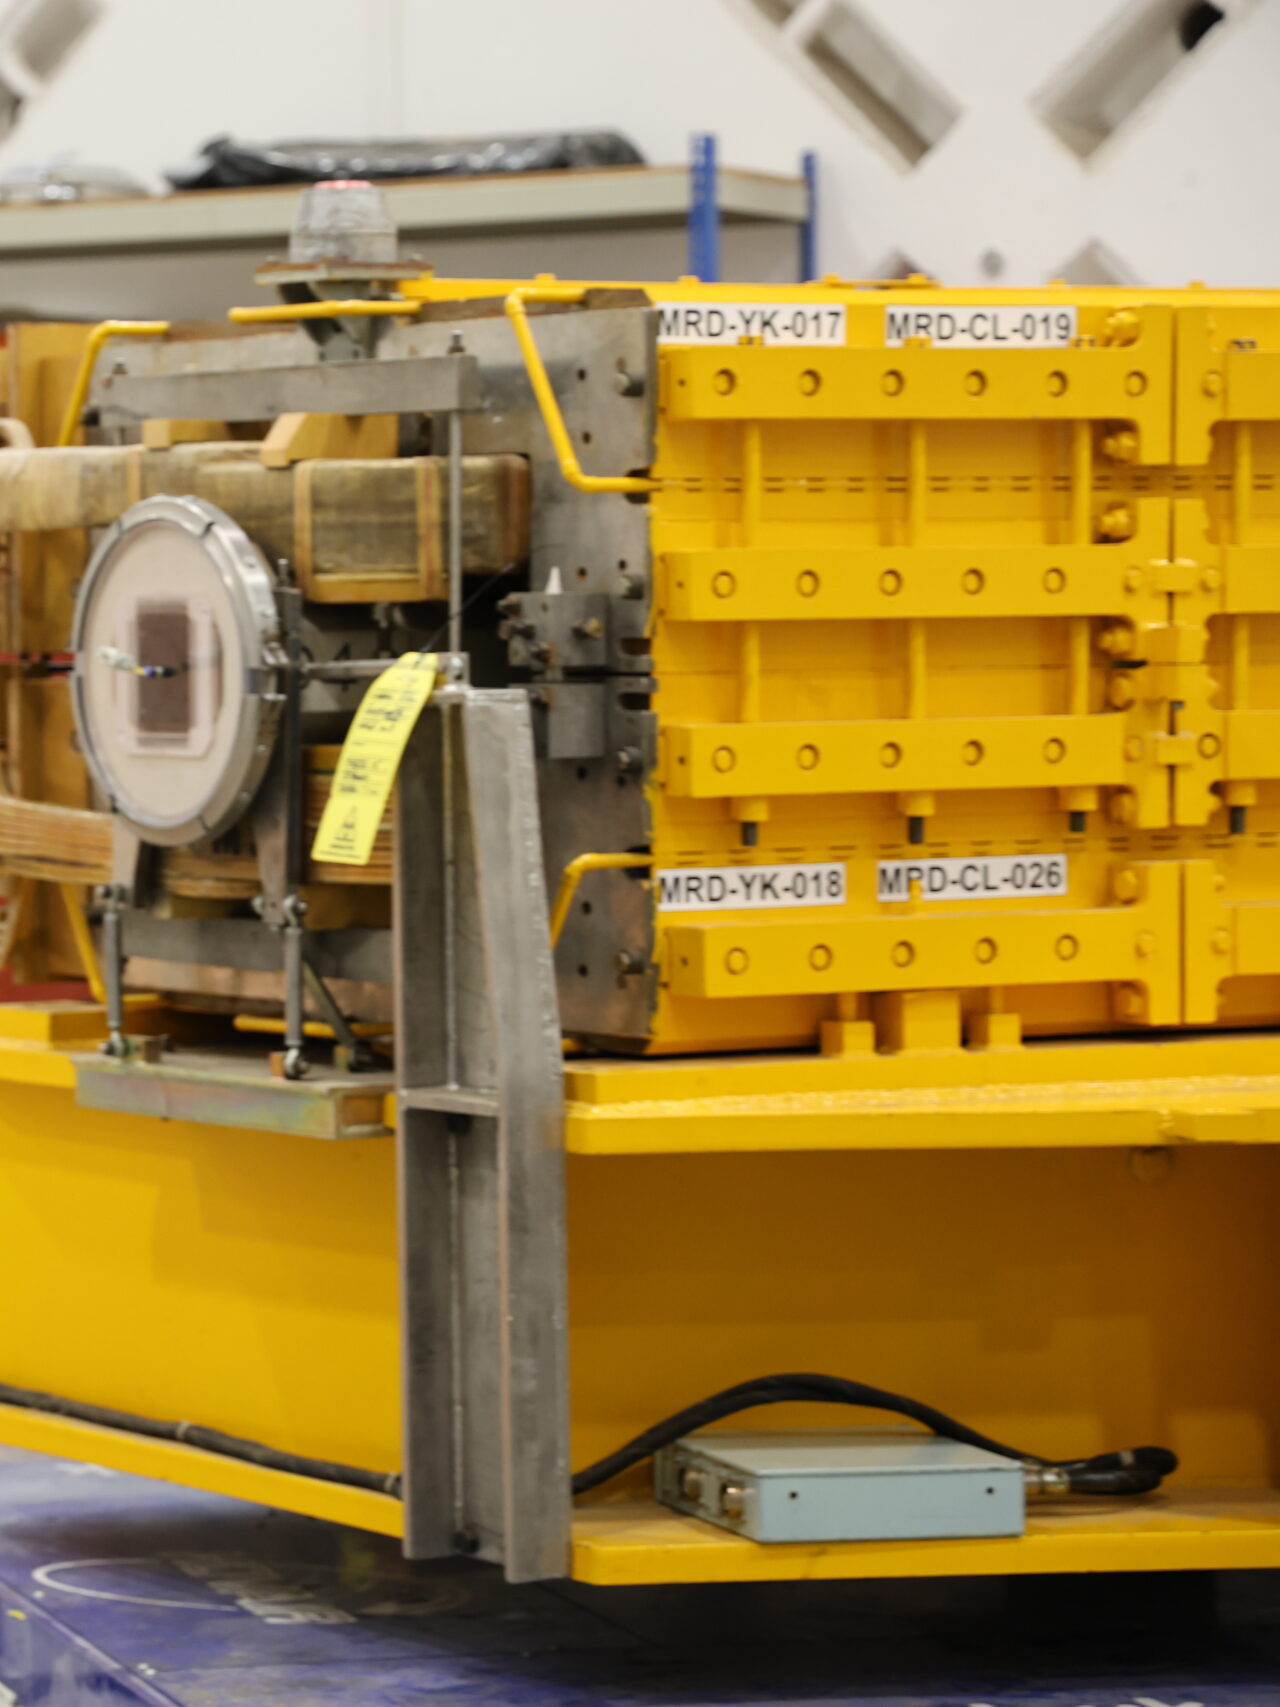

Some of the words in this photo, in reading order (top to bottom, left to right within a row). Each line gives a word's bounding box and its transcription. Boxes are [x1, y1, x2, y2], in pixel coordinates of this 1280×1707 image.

[657, 309, 841, 338] MRD-YK-017
[887, 313, 1071, 341] MRD-CL-019
[658, 870, 841, 903] MRD-YK-018
